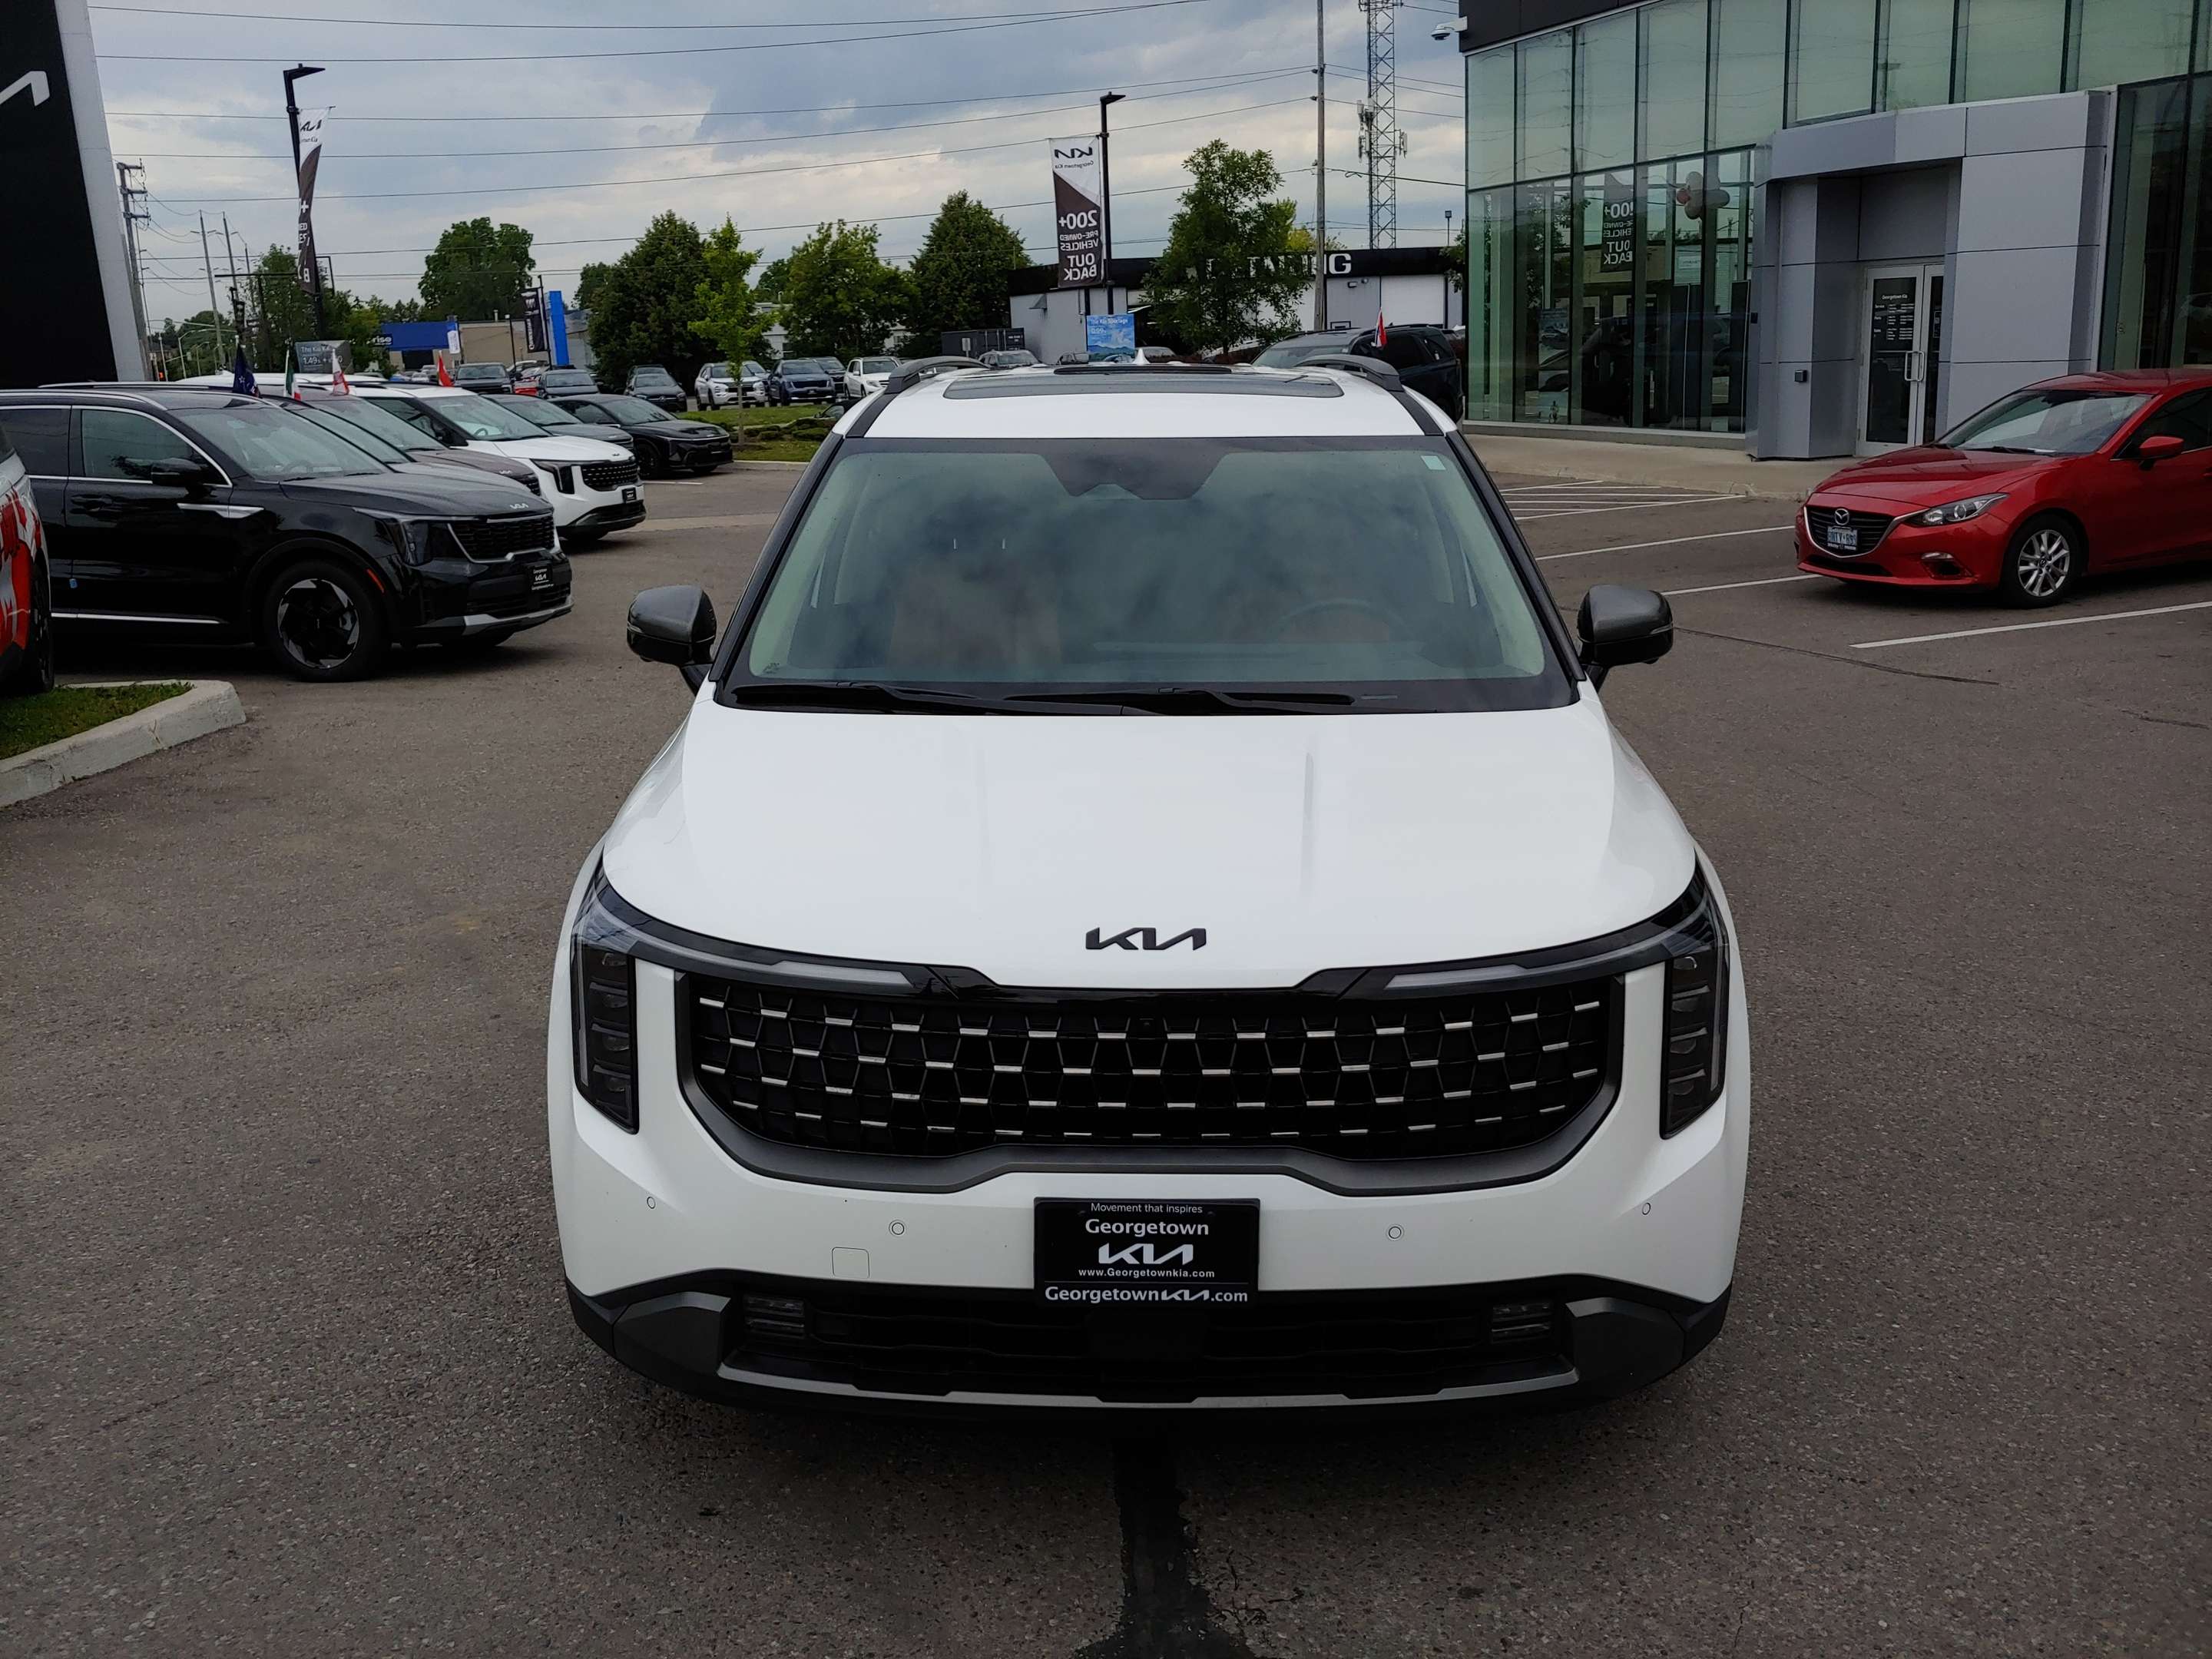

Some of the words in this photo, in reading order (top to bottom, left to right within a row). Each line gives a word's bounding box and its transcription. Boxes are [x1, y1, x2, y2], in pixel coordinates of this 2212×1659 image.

[1085, 926, 1207, 952] KIA
[1091, 1202, 1142, 1213] Movement
[1144, 1204, 1164, 1213] that
[1166, 1204, 1204, 1214] inspires
[1084, 1218, 1209, 1237] Georgetown
[1098, 1242, 1194, 1266] KIA
[1078, 1267, 1215, 1279] www.Georgetownkia.com
